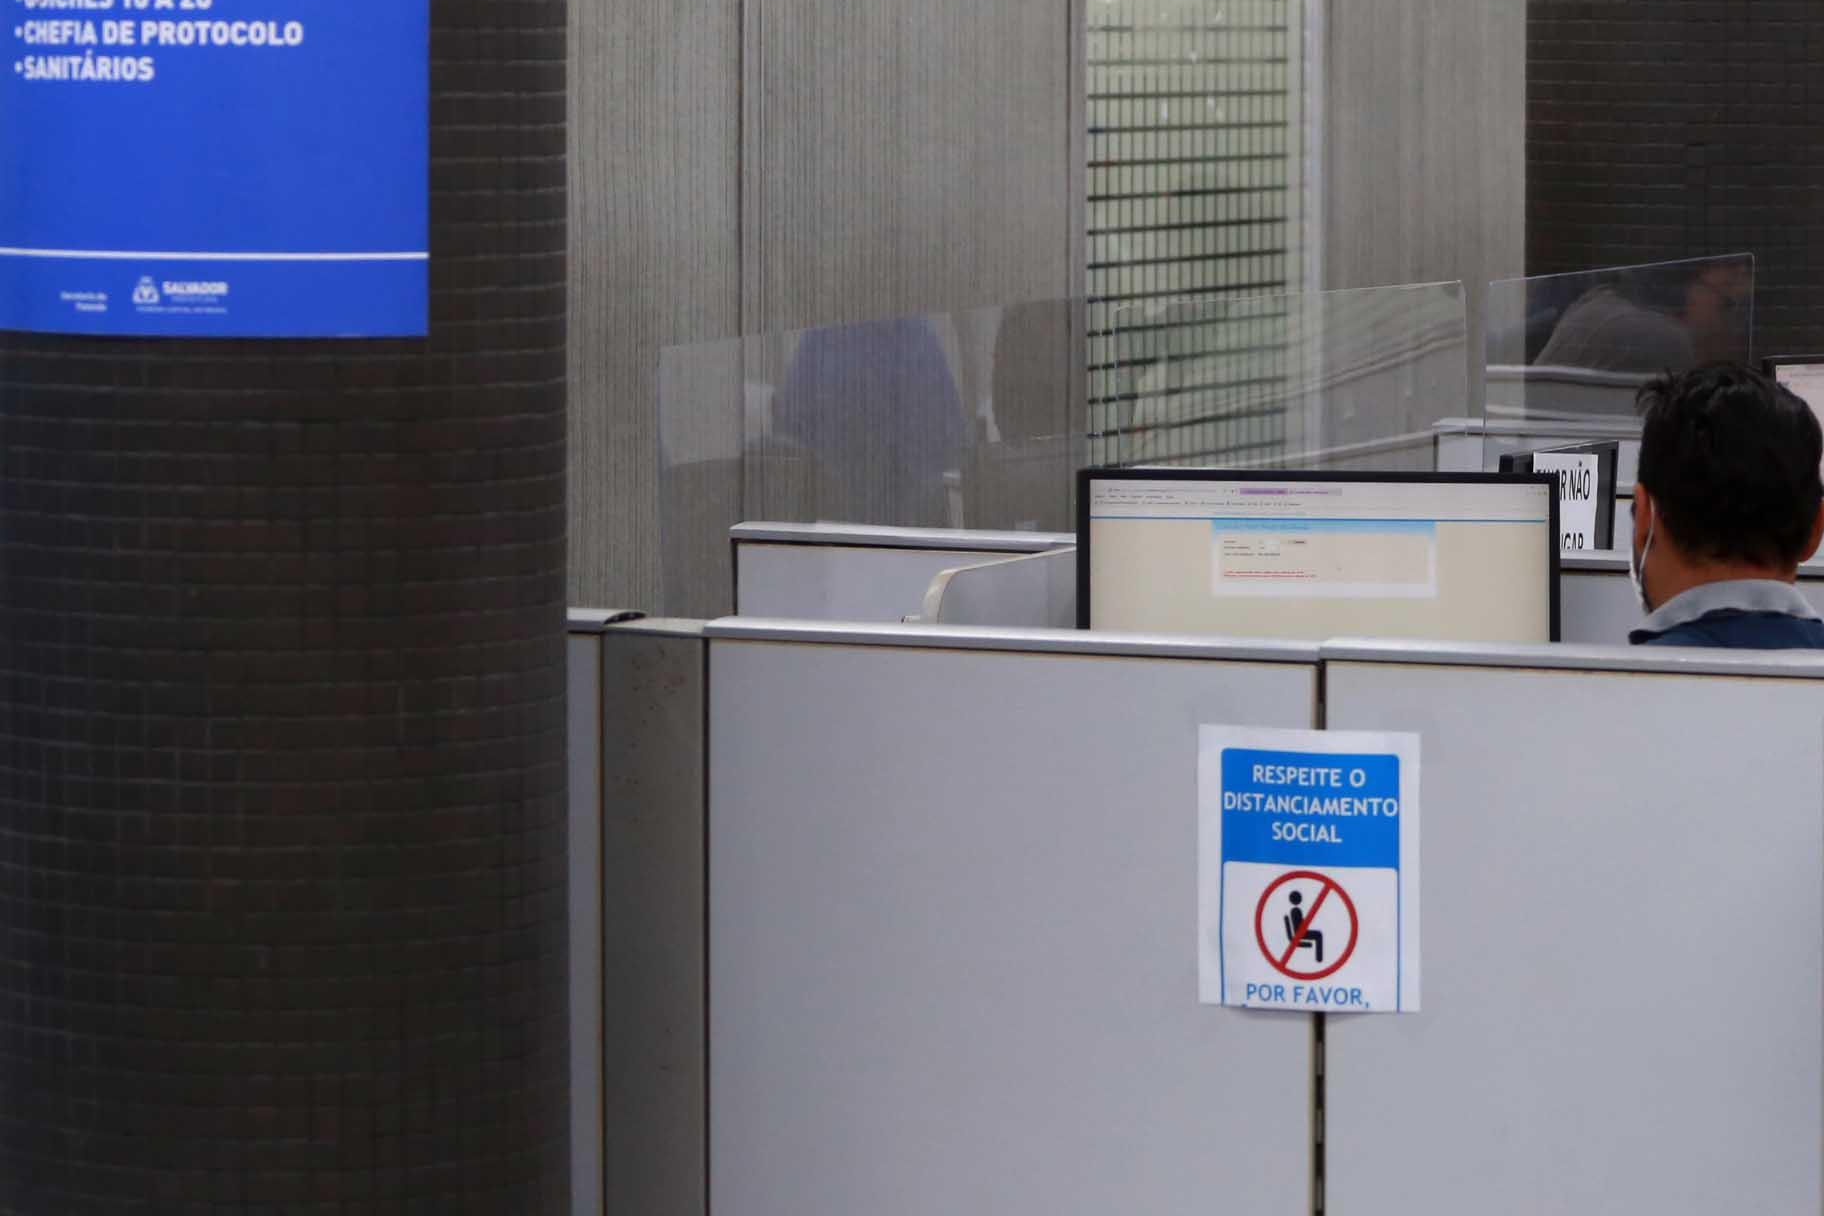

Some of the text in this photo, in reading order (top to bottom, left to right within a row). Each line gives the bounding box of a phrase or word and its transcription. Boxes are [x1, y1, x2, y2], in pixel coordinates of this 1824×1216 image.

[24, 20, 304, 46] CHEFIA DE PROTOCOLO
[24, 49, 155, 81] SANITÁRIOS
[1569, 461, 1591, 501] NÃO
[1252, 764, 1366, 787] RESPEITE O
[1224, 791, 1398, 817] DISTANCIAMENTO
[1271, 822, 1342, 843] SOCIAL
[1246, 983, 1371, 1009] POR FAVOR,
